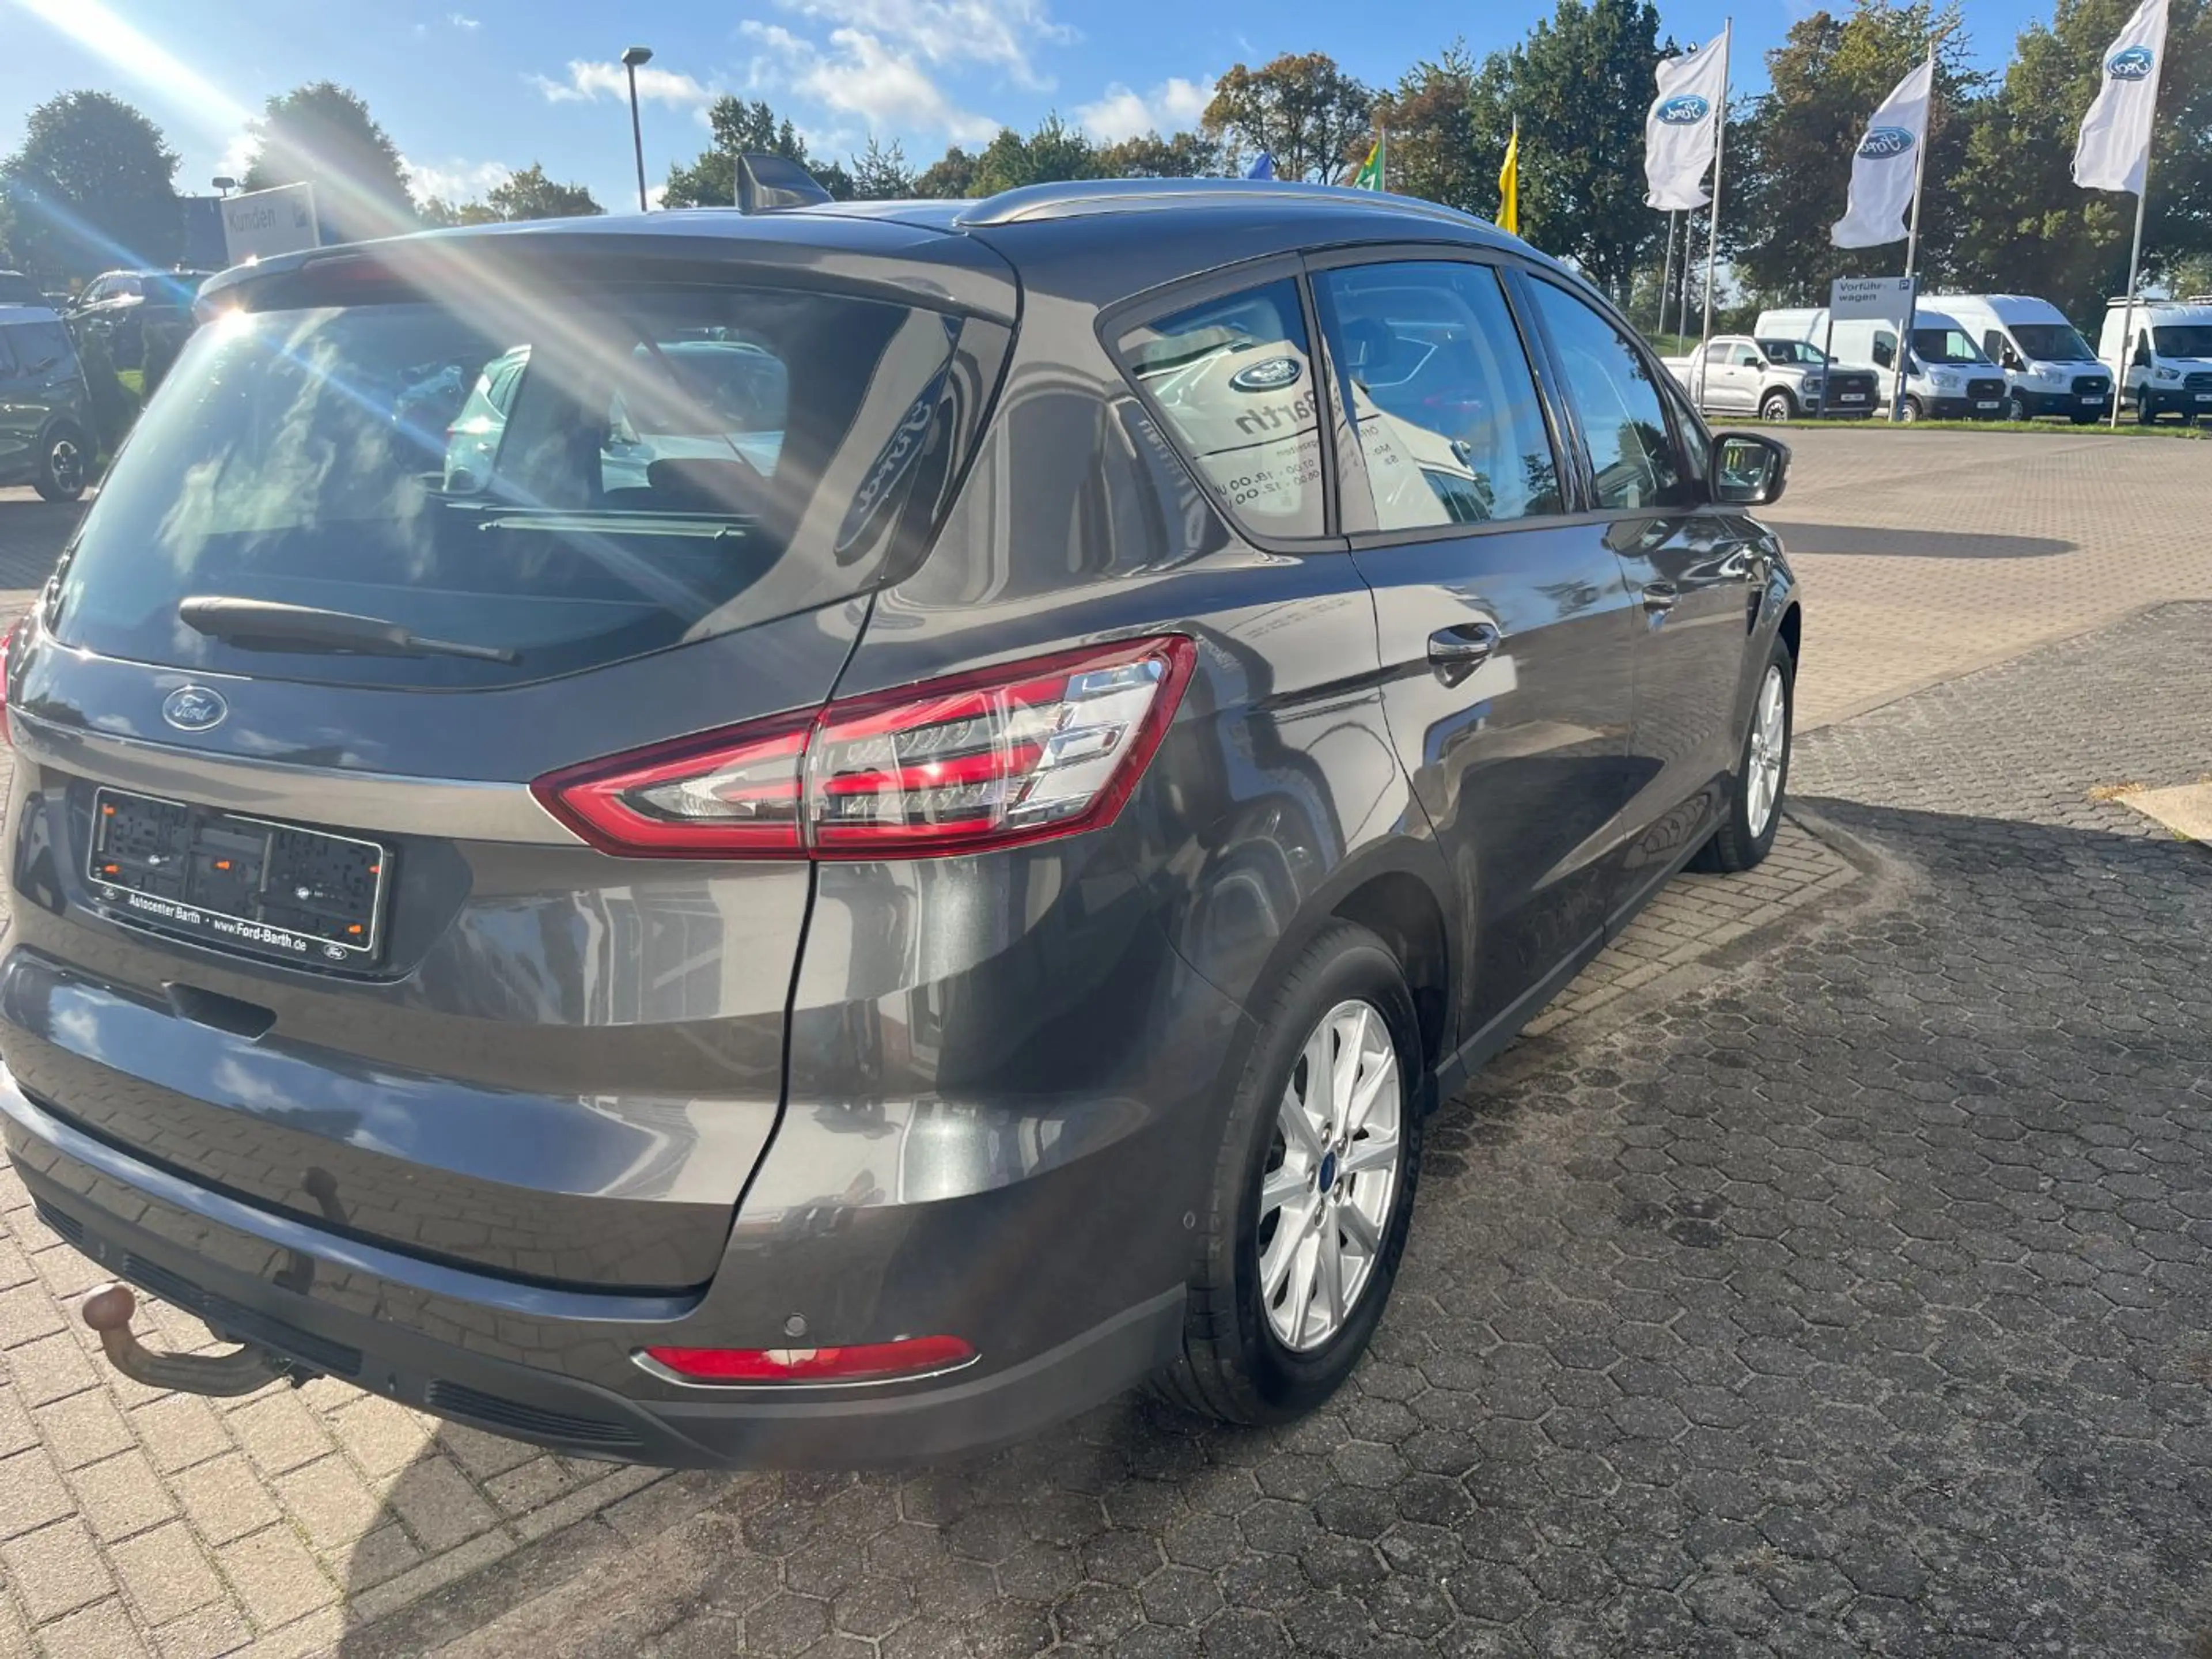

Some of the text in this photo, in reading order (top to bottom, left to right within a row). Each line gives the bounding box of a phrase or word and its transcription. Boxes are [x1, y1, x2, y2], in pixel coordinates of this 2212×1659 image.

[227, 206, 276, 233] Kunden
[1839, 293, 1877, 302] wagen
[129, 893, 175, 918] Autocenter
[176, 906, 200, 924] Barth
[214, 919, 307, 952] www.Ford-Barth.de
